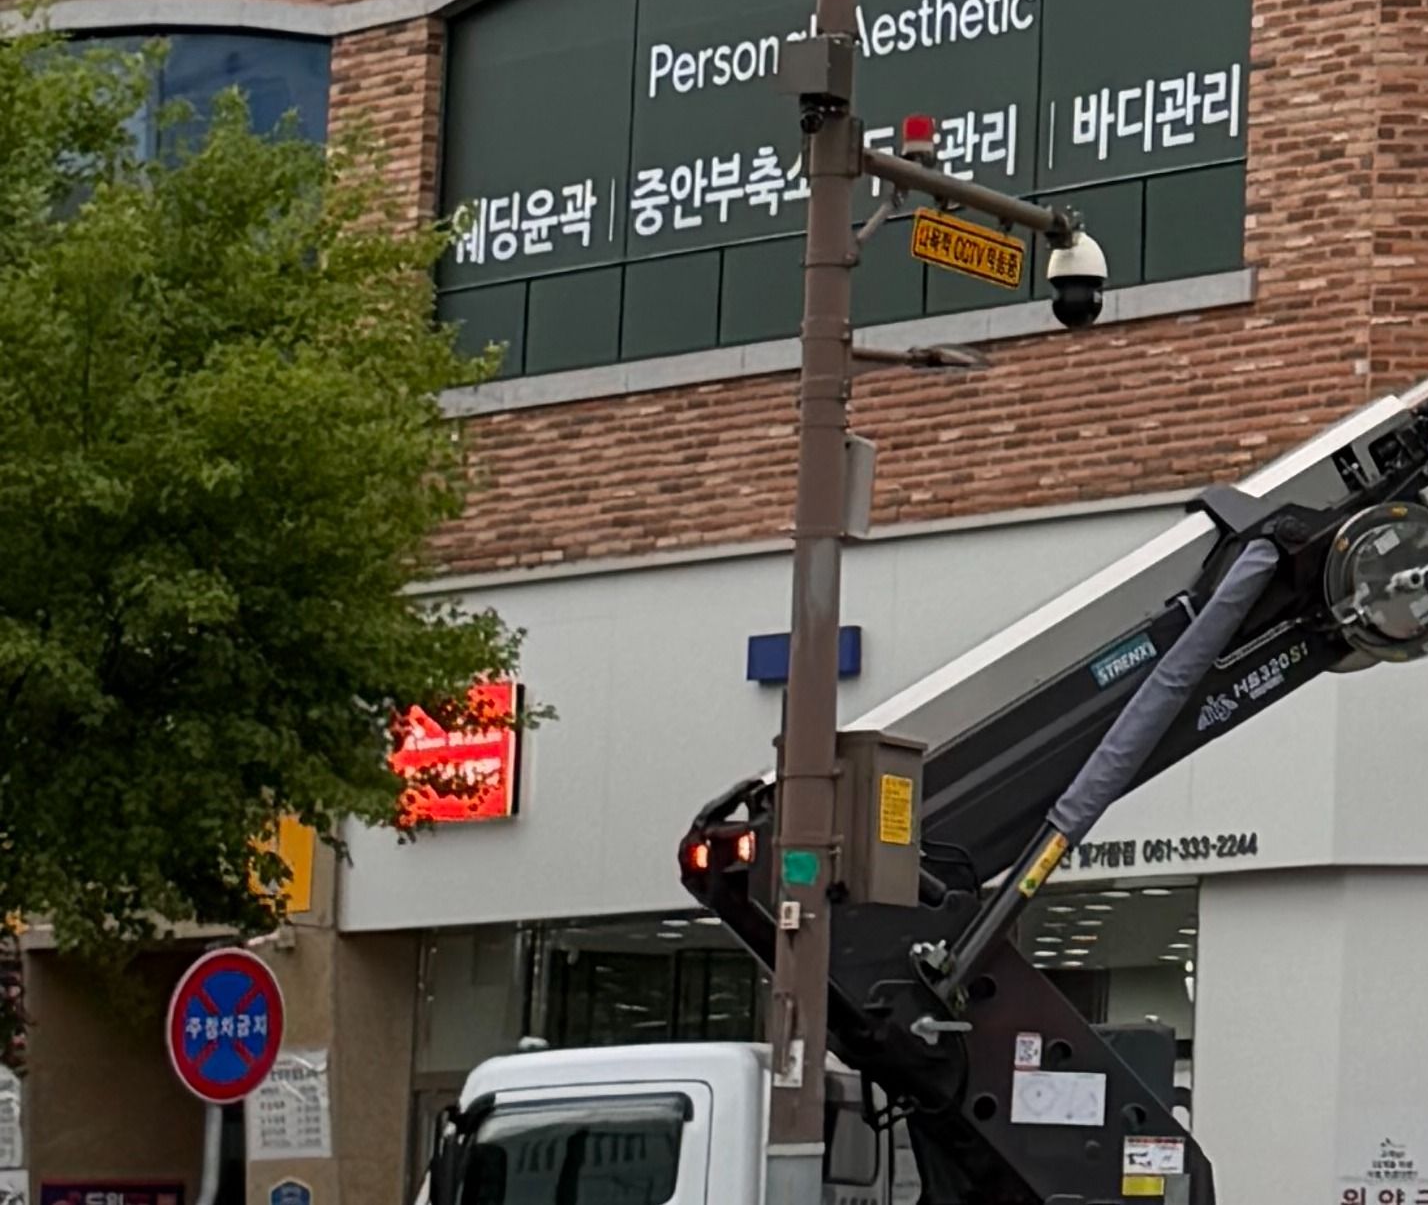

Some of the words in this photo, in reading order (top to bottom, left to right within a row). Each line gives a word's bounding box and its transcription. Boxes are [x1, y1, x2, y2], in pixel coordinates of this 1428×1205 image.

[648, 13, 818, 99] Person
[863, 103, 1018, 198] 두관리
[1073, 63, 1241, 162] 바디관리
[1142, 831, 1259, 864] 061-333-2244
